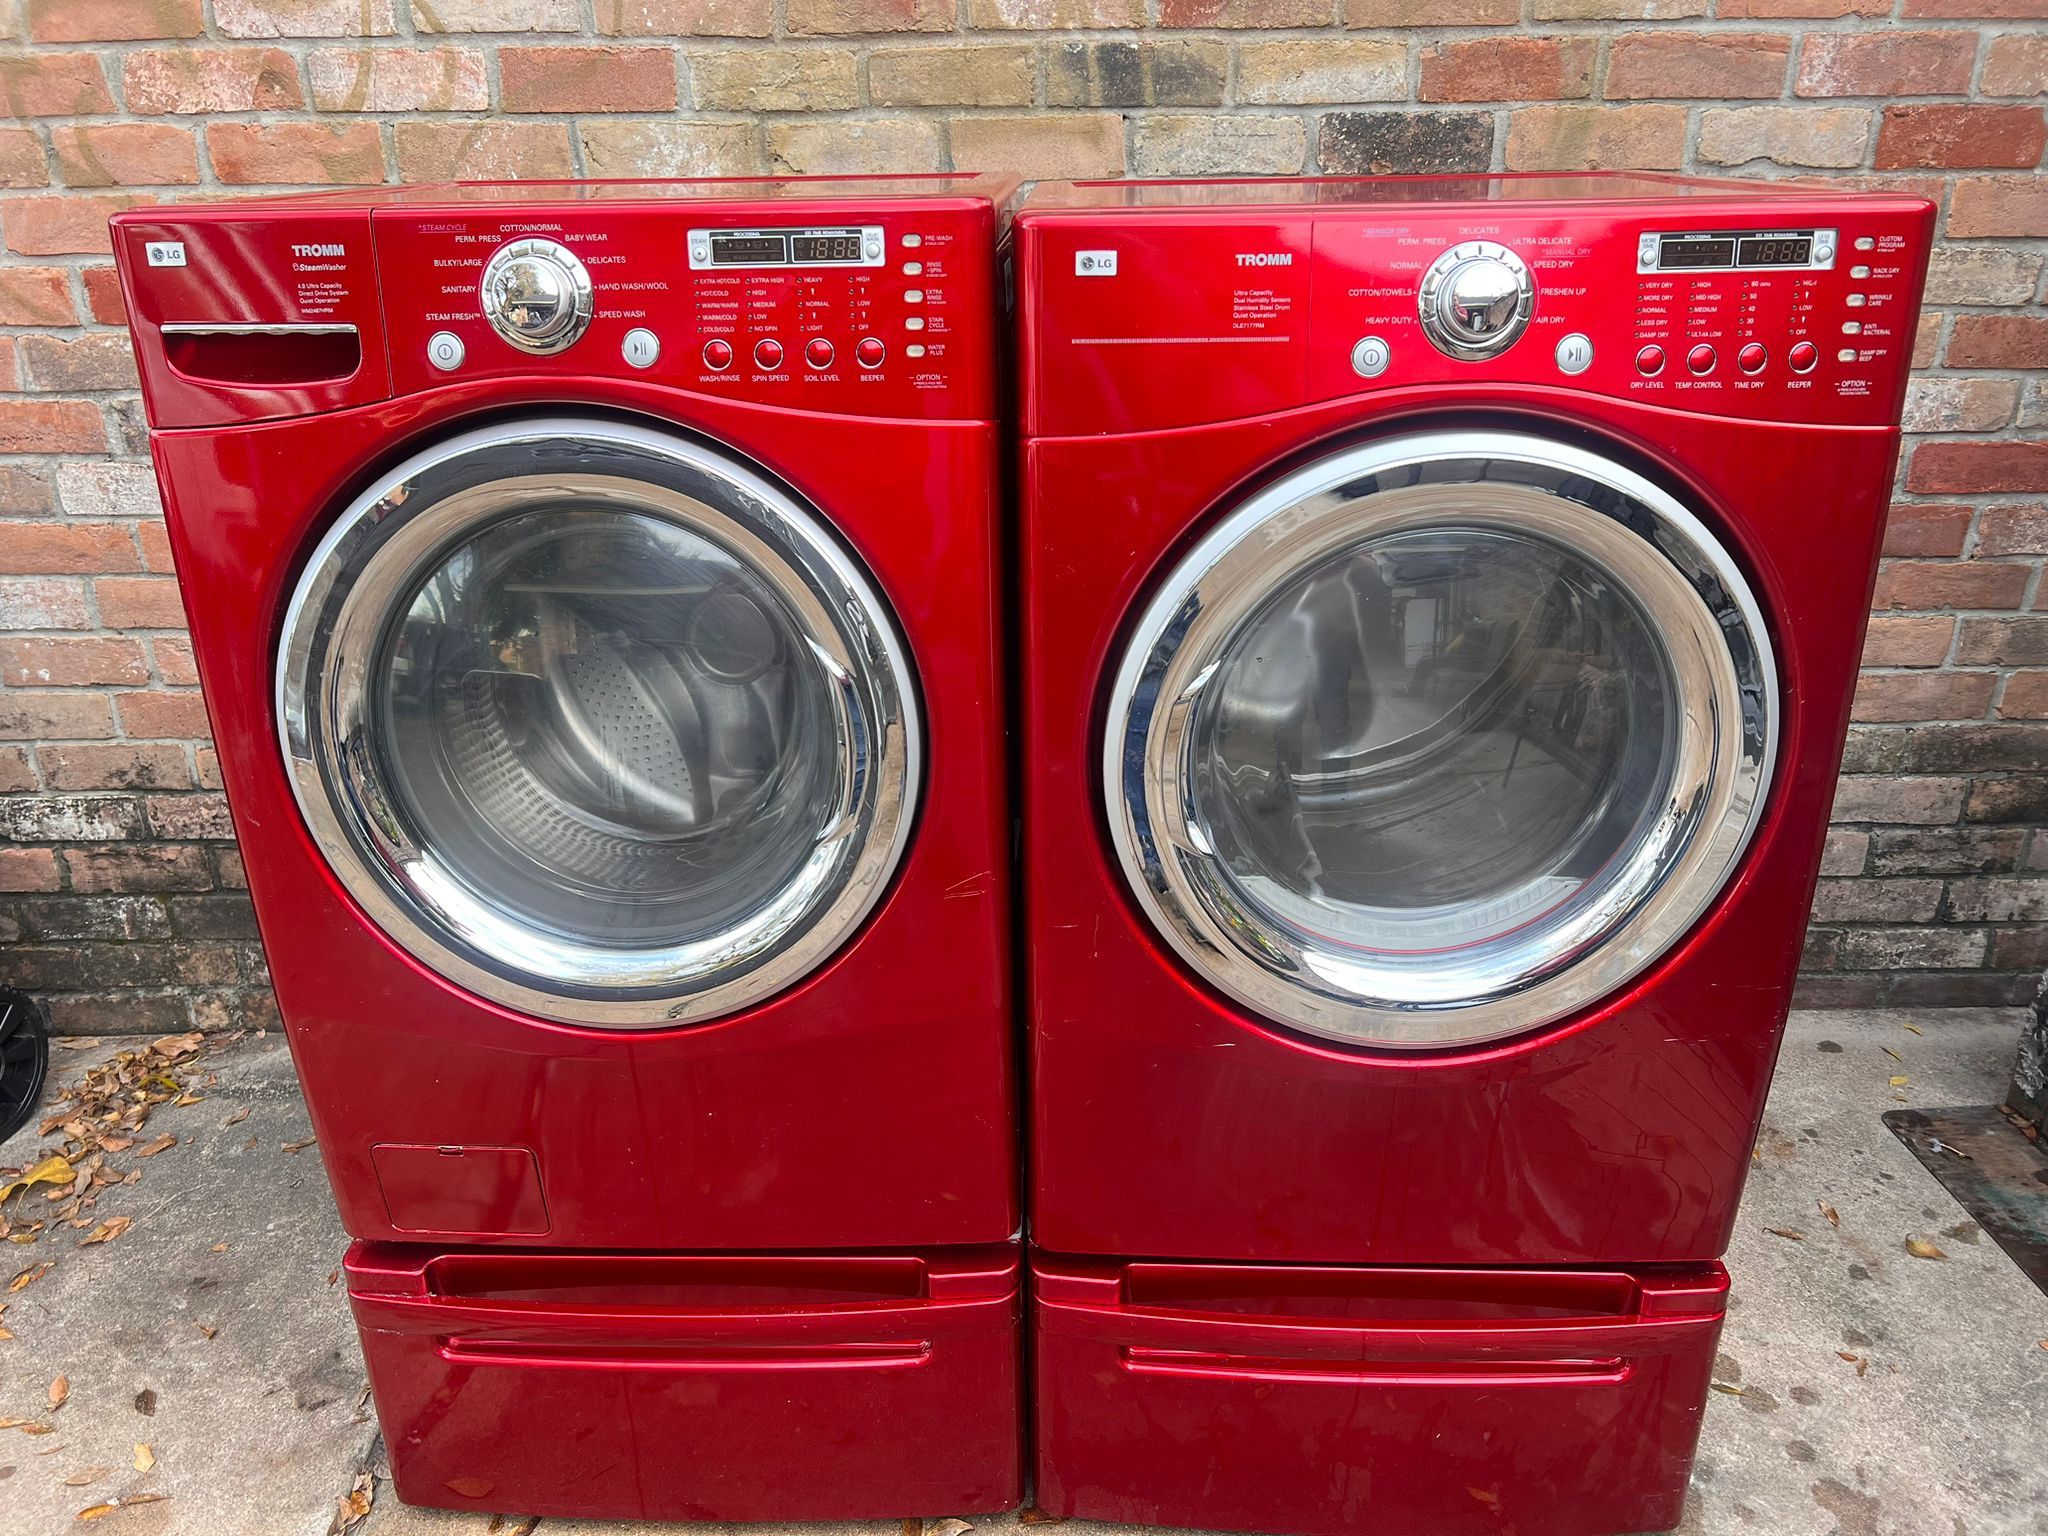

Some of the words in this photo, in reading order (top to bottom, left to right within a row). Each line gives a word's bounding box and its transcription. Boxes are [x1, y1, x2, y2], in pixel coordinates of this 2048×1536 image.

[500, 224, 563, 232] COTTON/NORMAL
[564, 234, 584, 242] BABY
[291, 244, 345, 257] TROMM
[587, 256, 626, 264] DELICATES
[1235, 253, 1292, 266] TROMM
[299, 263, 347, 272] SteamWasher
[320, 282, 342, 290] Capacity
[441, 286, 476, 294] SANITARY
[598, 282, 620, 290] HAND
[622, 282, 668, 290] WASH/WOOL
[1348, 288, 1412, 296] COTTON/TOWELS
[1541, 288, 1574, 296] FRESHEN
[623, 310, 646, 318] WASH
[1365, 316, 1390, 324] HEAVY
[1392, 316, 1412, 324] DUTY
[1549, 316, 1566, 324] DRY
[804, 374, 819, 382] SOIL
[820, 374, 840, 382] LEVEL
[860, 374, 884, 382] BEEPER
[1842, 380, 1866, 388] OPTION
